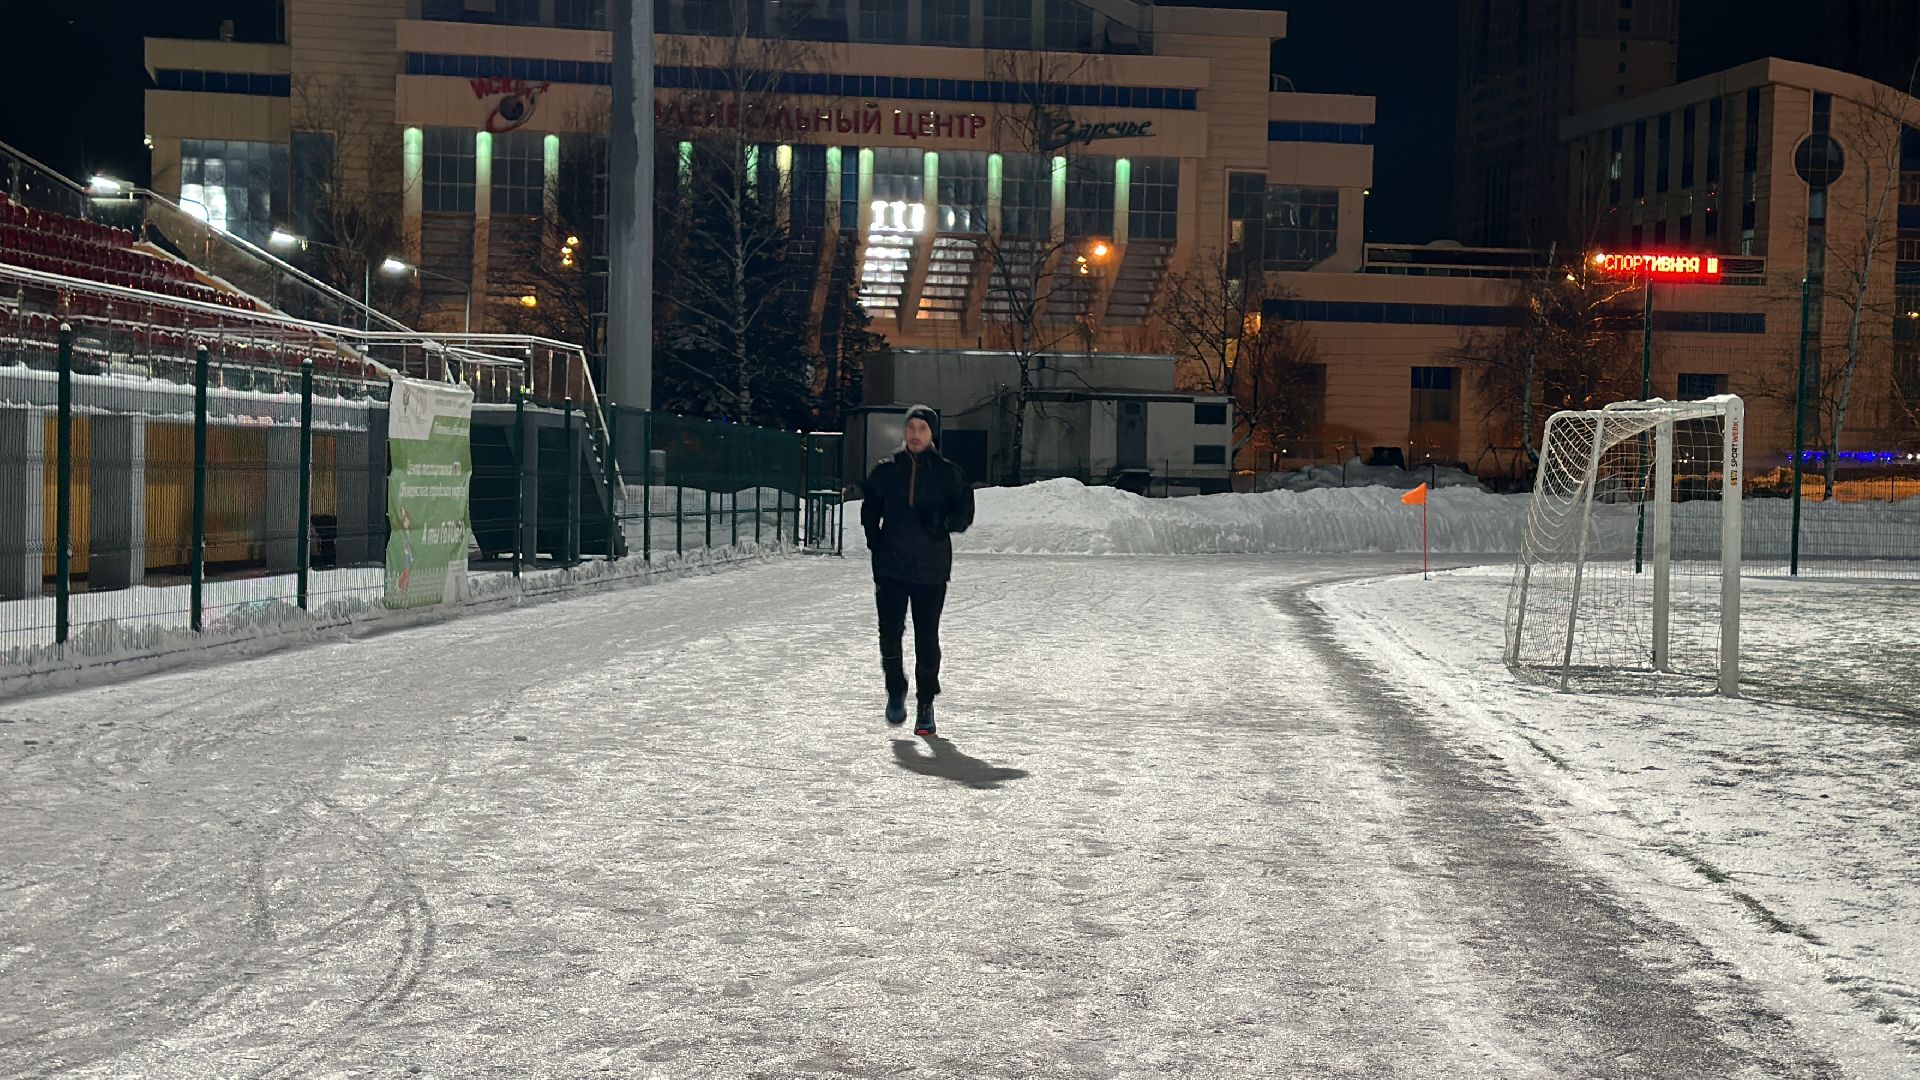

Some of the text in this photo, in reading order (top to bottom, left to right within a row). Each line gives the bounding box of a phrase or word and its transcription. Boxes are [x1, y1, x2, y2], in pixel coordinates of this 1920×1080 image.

[654, 102, 986, 139] ЛЕЙБОЛЬНЫЙ ЦЕНТР
[1604, 254, 1700, 273] СПОРТИВНАЯ
